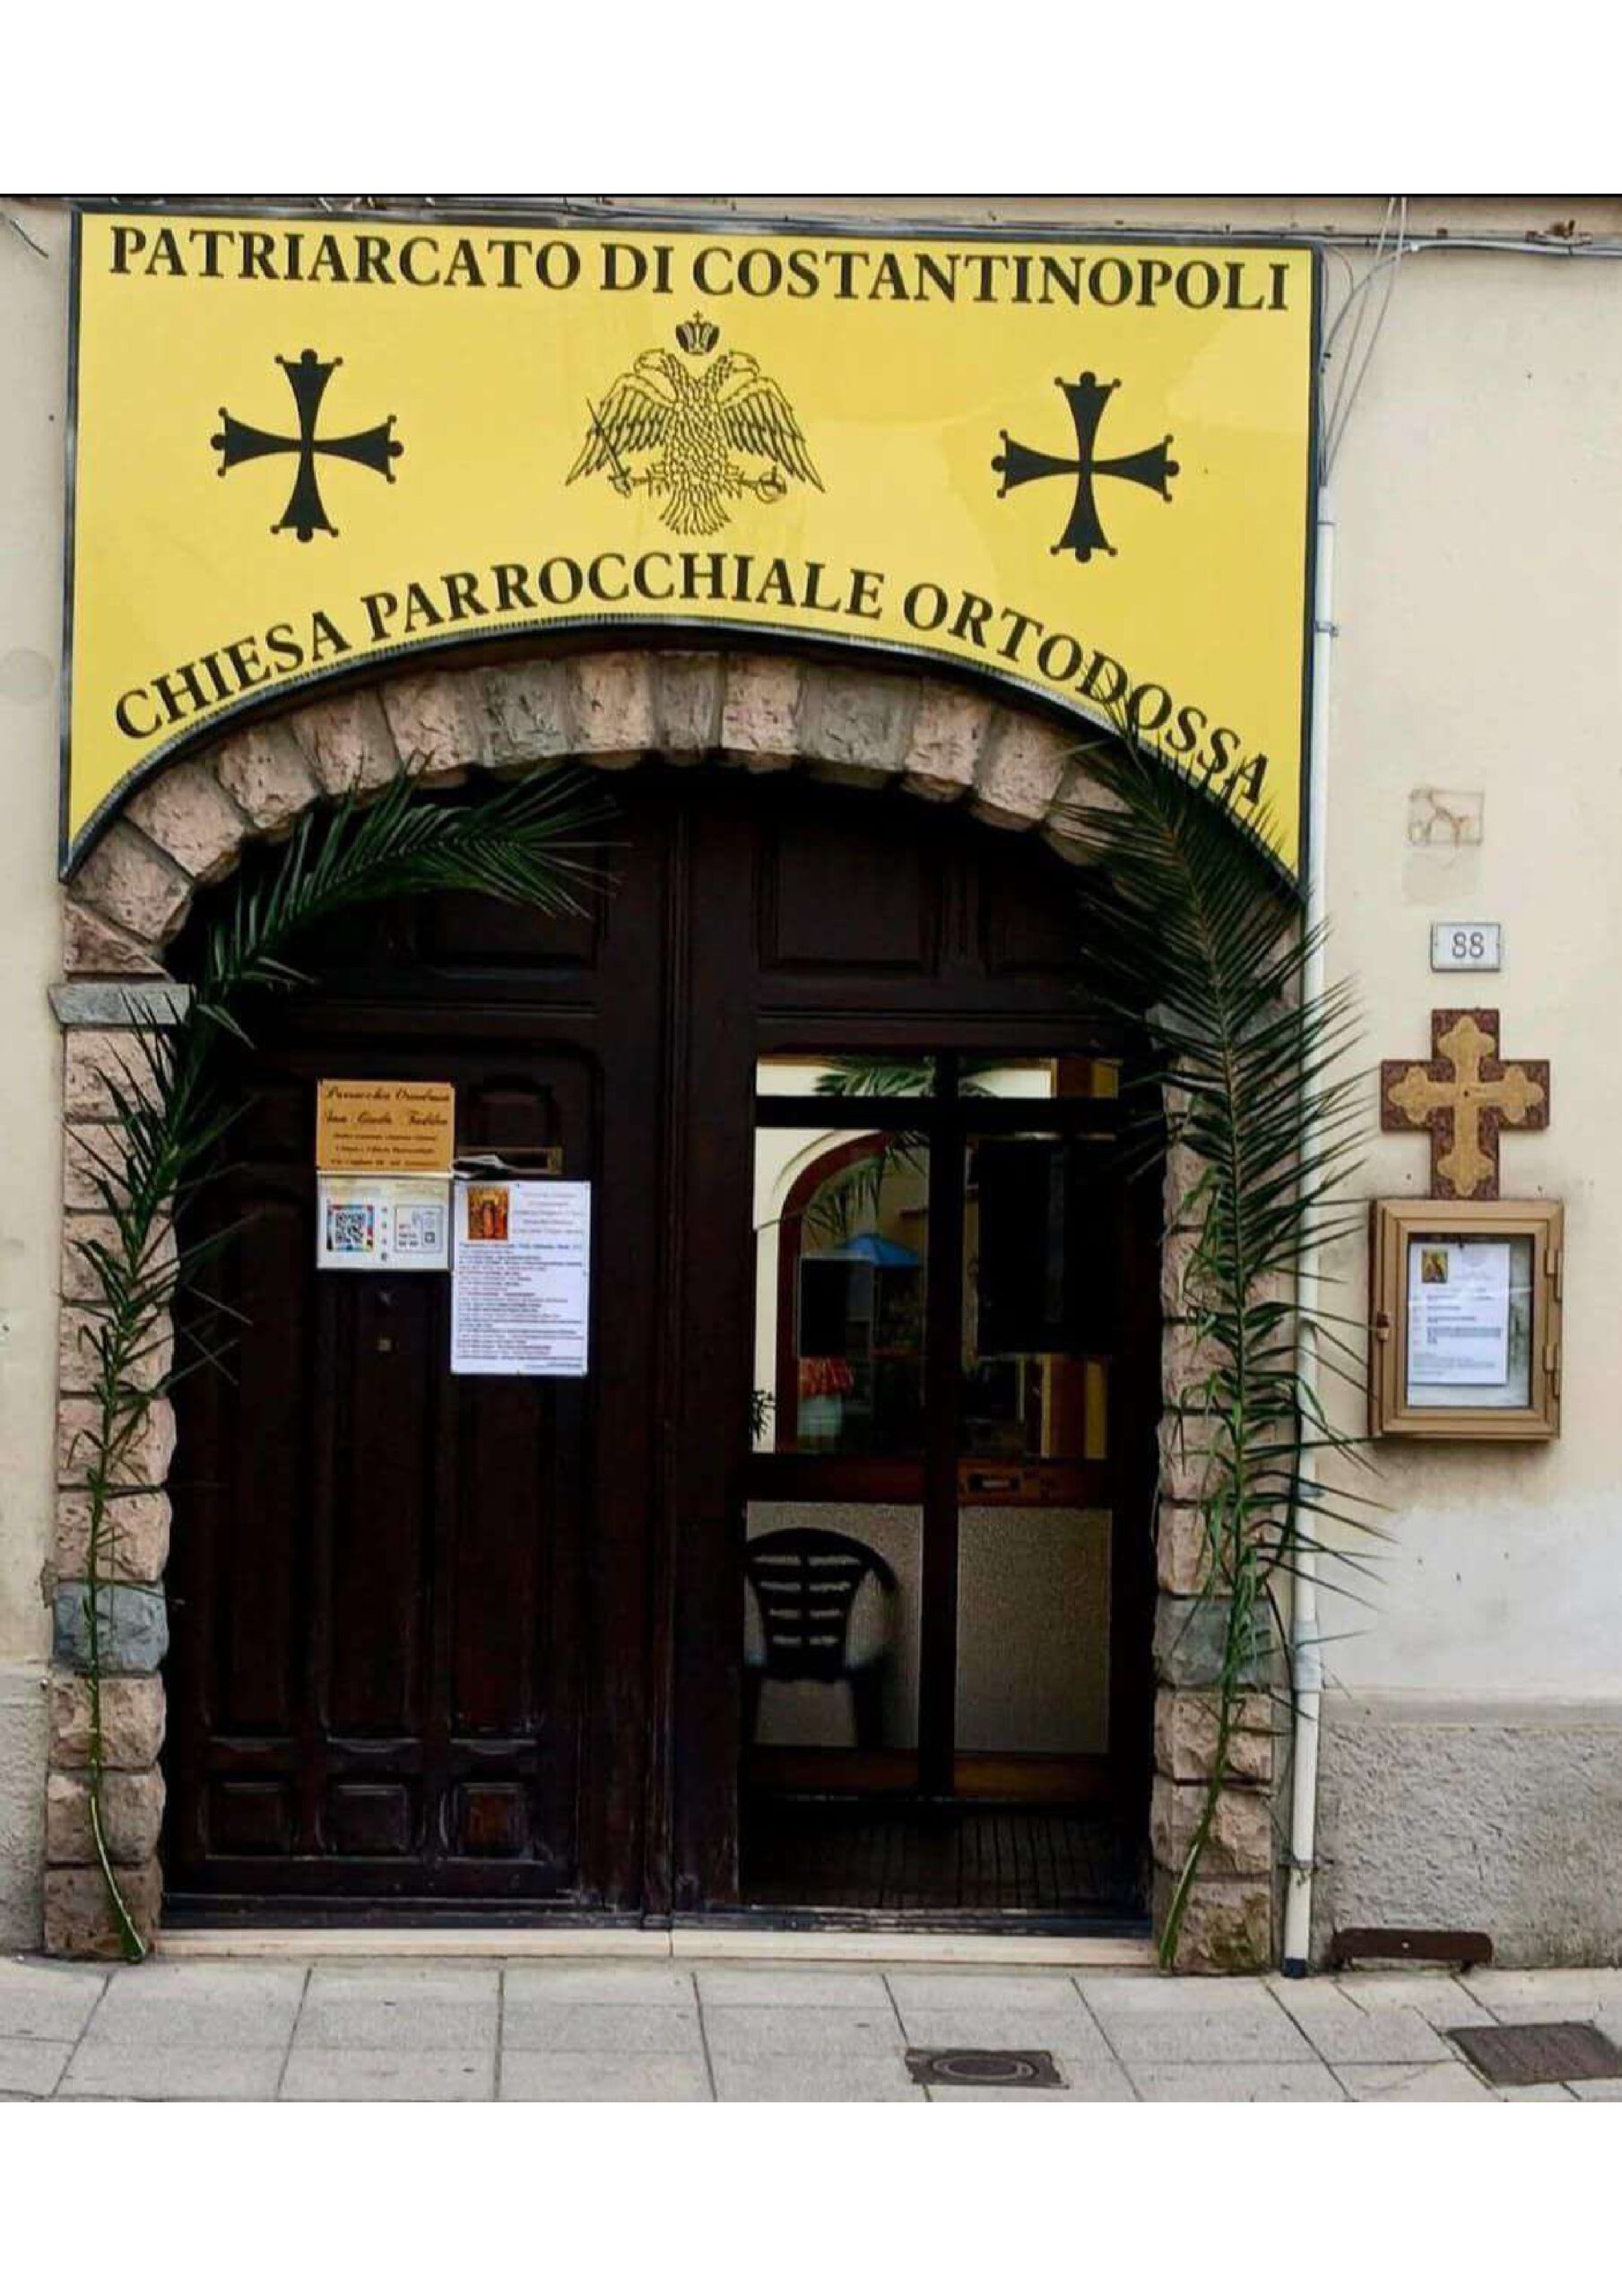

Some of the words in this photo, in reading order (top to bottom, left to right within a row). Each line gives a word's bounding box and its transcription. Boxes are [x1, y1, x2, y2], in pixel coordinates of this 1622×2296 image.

[110, 227, 581, 290] PATRIARCATO
[600, 243, 674, 293] DI
[692, 248, 1289, 310] COSTANTINOPOLI
[116, 611, 352, 739] CHIESA
[360, 552, 885, 642] PARROCCHIALE
[904, 583, 1269, 804] ORTODOSSA
[1452, 931, 1485, 959] 88
